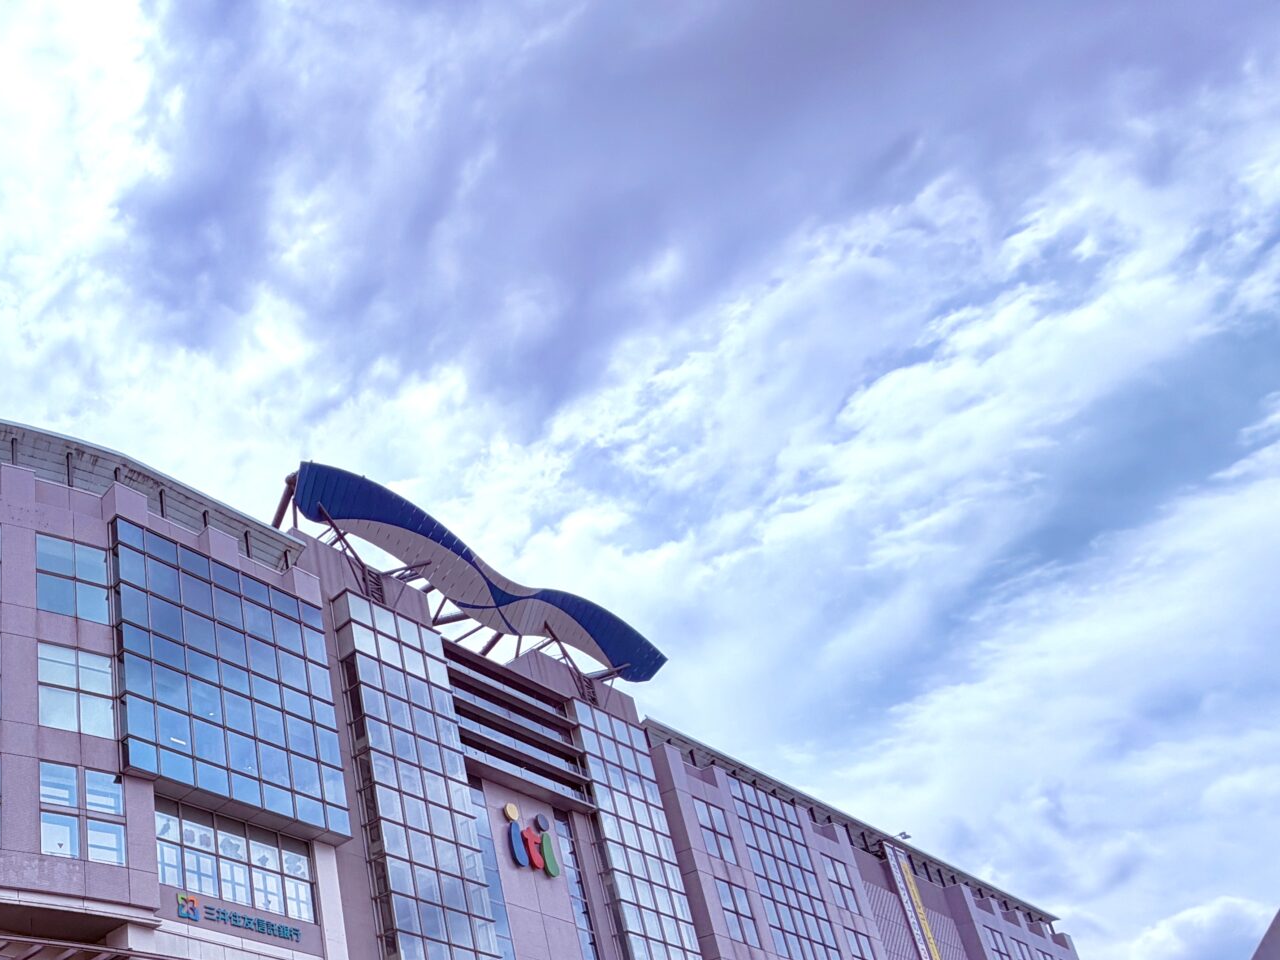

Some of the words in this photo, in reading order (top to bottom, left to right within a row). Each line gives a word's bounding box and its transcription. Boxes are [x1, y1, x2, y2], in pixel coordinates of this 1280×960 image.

[203, 904, 302, 943] 三井住友信託銀行
